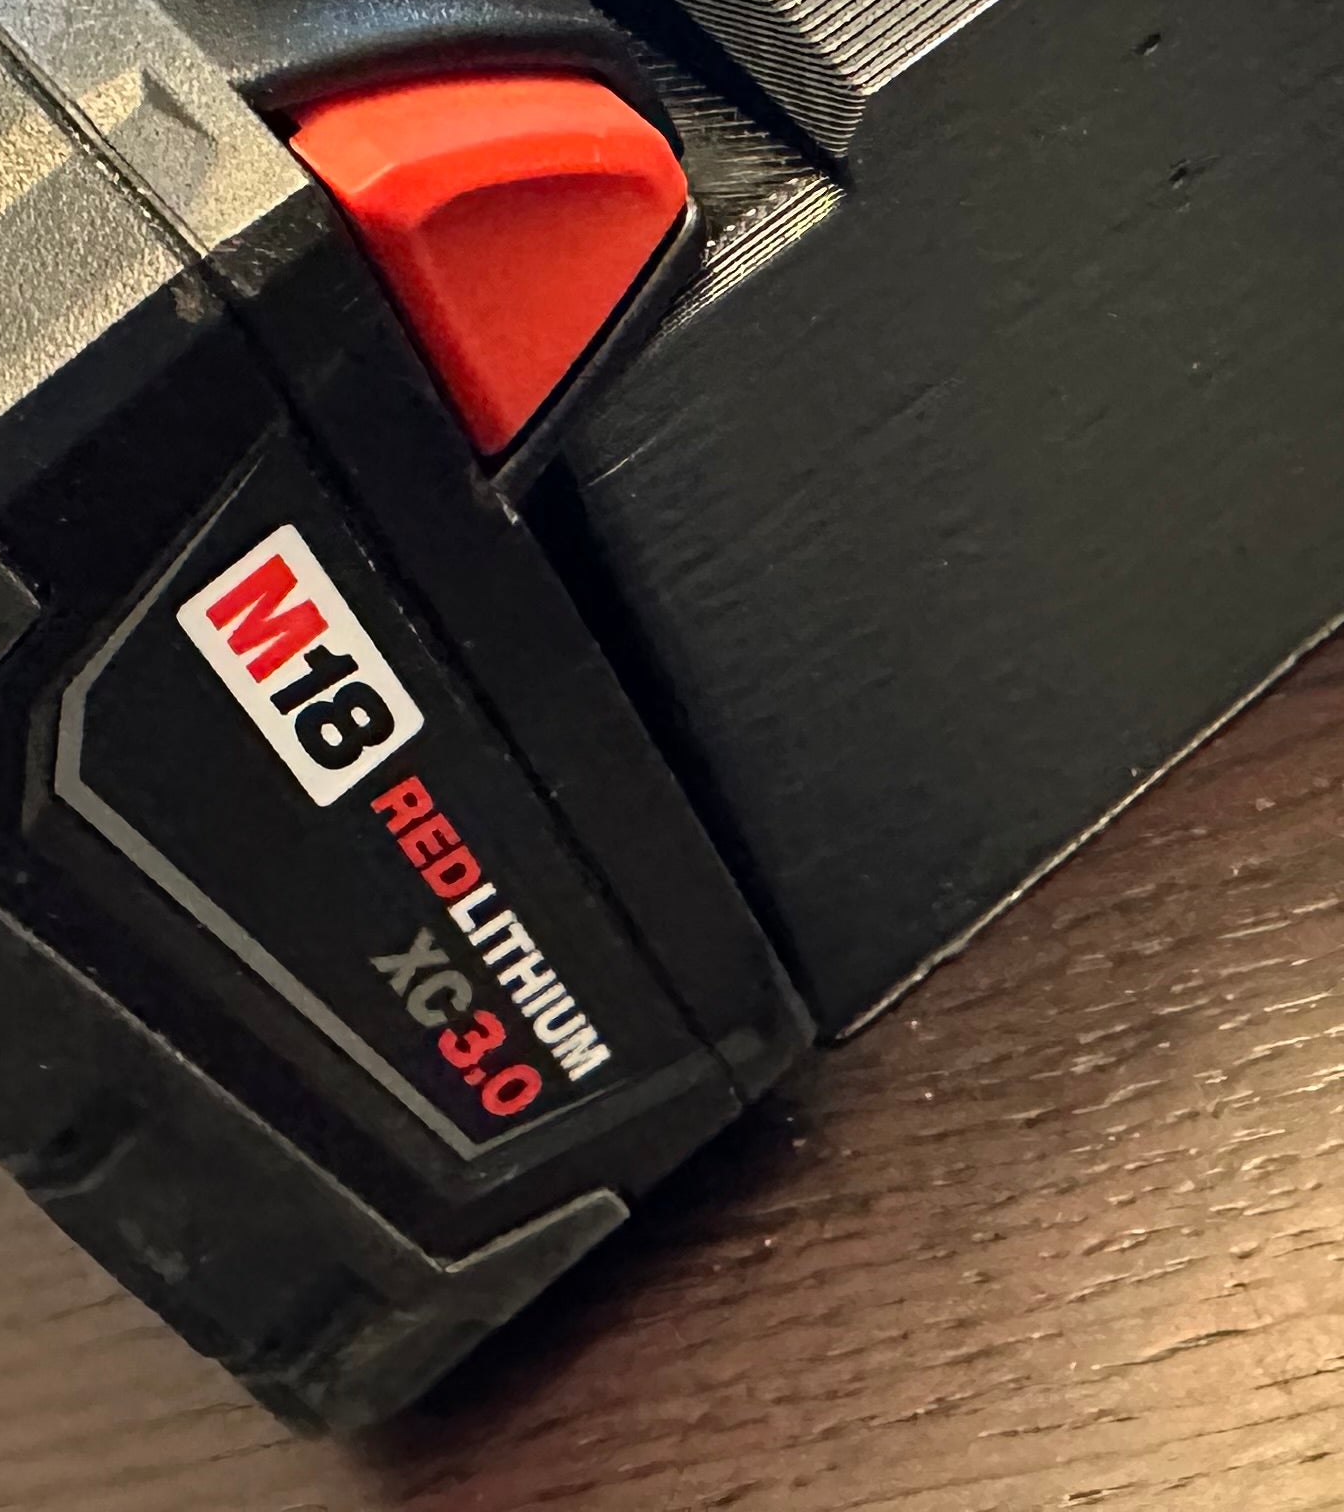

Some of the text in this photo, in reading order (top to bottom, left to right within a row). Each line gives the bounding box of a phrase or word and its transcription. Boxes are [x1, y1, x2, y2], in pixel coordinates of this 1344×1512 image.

[204, 553, 613, 1083] M18 REDLITHIUM
[368, 925, 543, 1117] XC3.0
